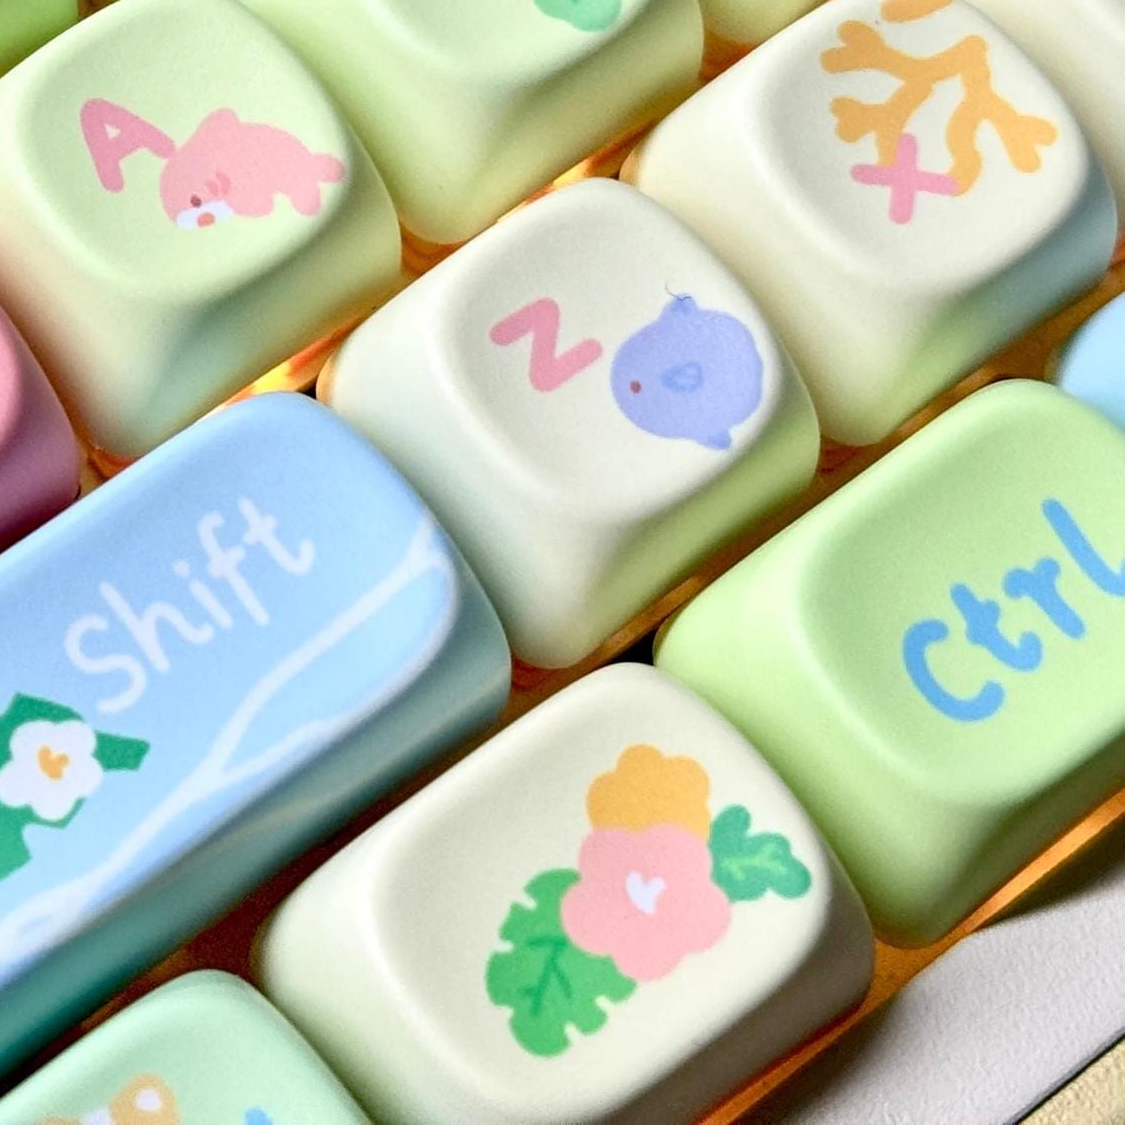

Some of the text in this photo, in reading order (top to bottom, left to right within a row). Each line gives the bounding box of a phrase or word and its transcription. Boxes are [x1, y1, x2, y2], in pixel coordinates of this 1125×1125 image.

[79, 97, 176, 193] A
[849, 132, 963, 225] X
[488, 297, 603, 393] Z
[63, 496, 316, 714] Shift
[901, 497, 1125, 723] Ctrl
